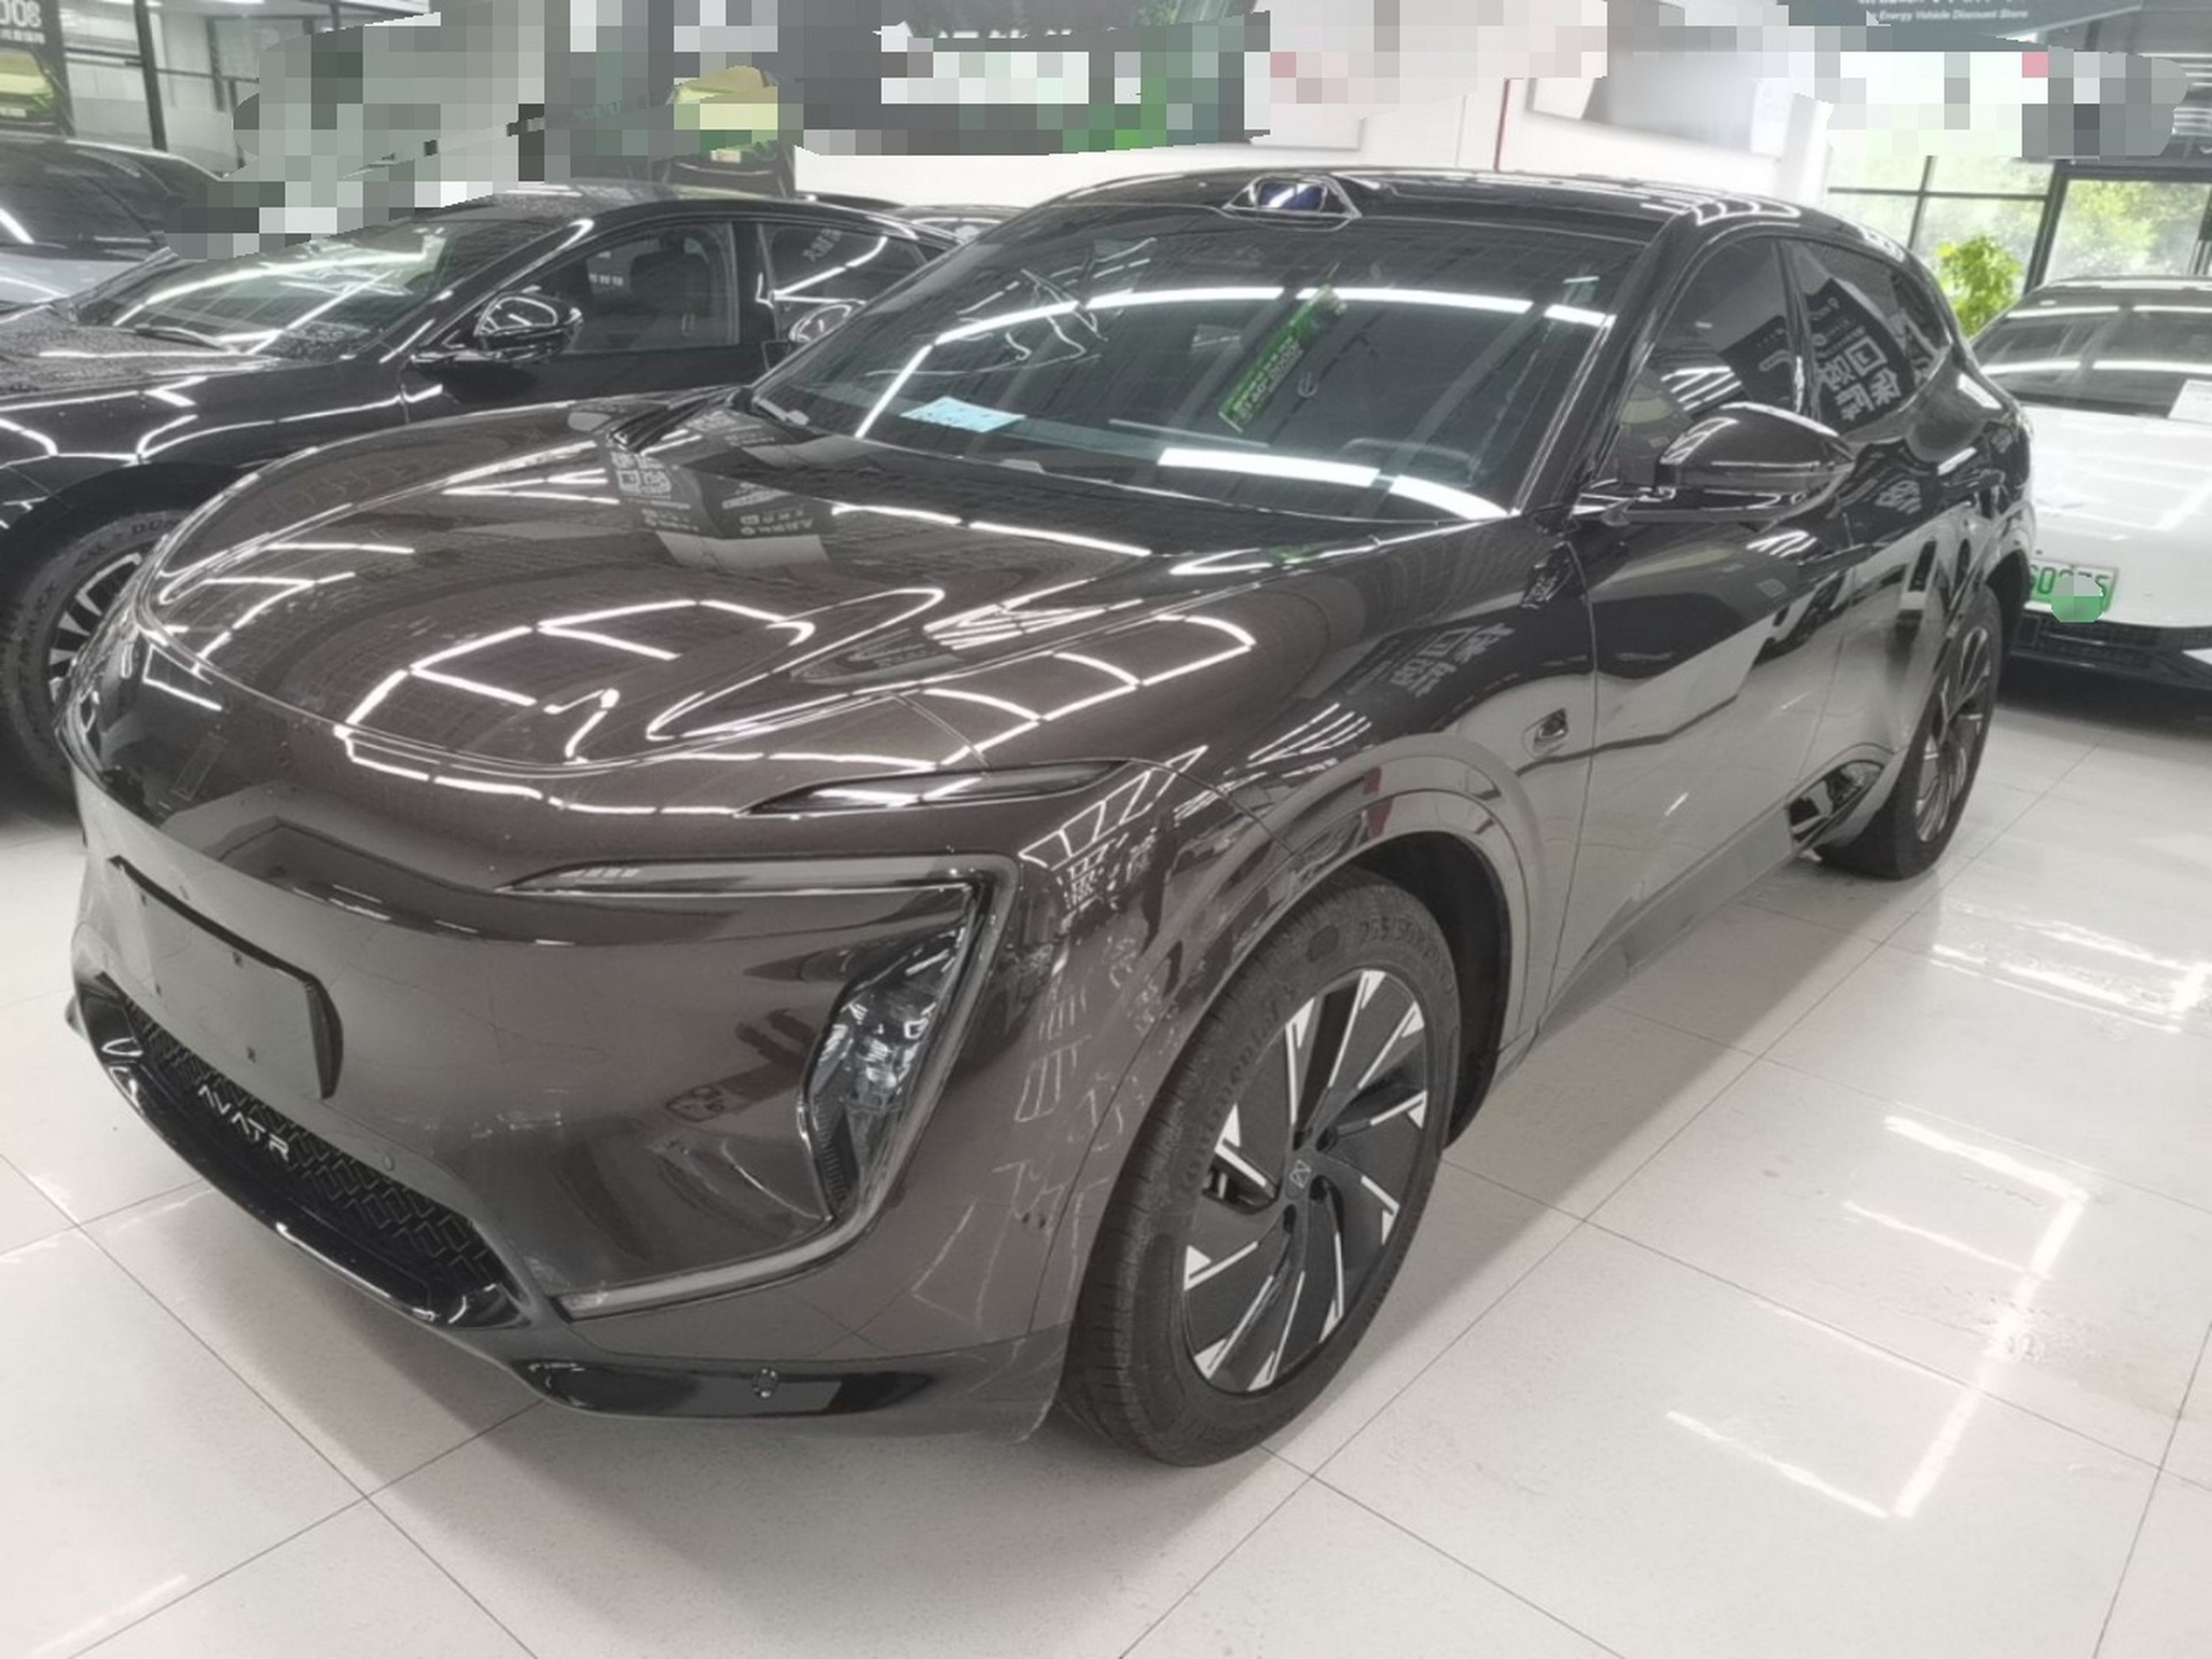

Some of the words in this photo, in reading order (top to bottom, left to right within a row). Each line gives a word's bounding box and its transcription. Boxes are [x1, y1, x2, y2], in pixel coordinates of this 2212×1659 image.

[1915, 10, 1950, 20] Vehicle
[1952, 10, 1997, 20] Discount
[1999, 9, 2028, 18] Store
